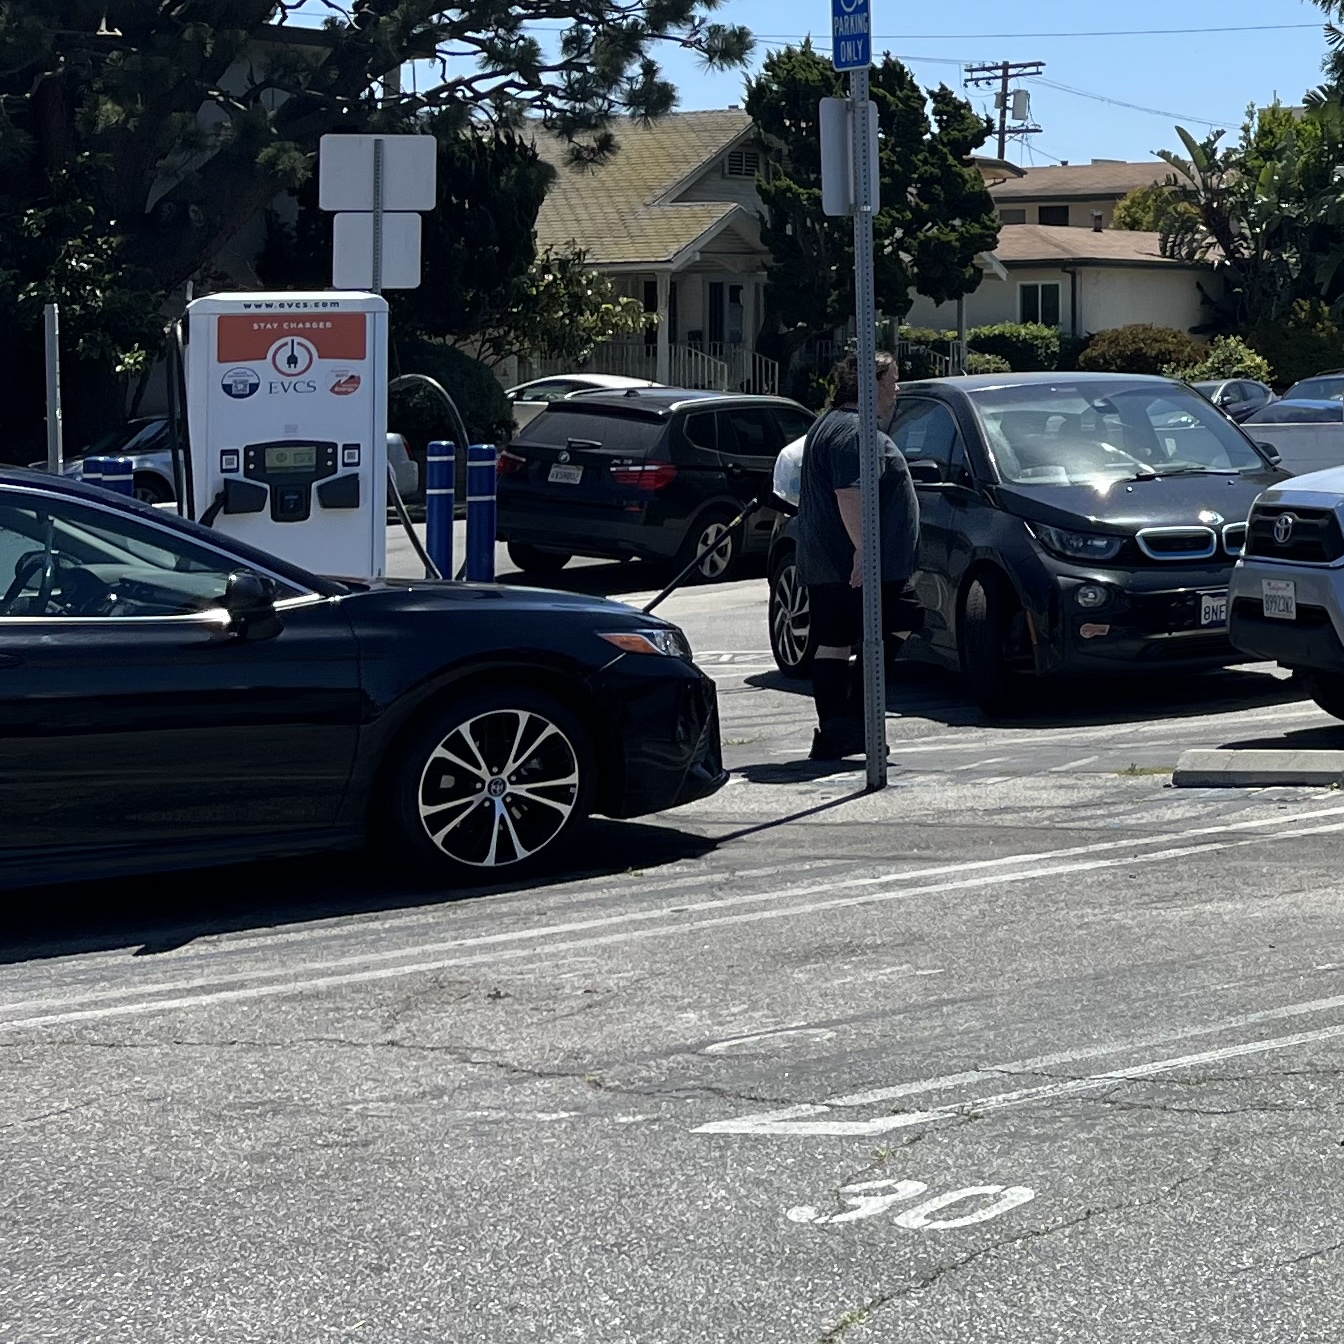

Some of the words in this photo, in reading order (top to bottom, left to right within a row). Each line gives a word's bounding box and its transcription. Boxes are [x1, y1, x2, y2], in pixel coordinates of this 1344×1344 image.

[834, 12, 868, 37] PARKING
[840, 39, 863, 62] ONLY
[243, 301, 340, 310] www.evcs.com
[253, 322, 278, 330] STAY
[282, 321, 332, 330] CHARGED
[268, 380, 317, 395] EVCS
[786, 1180, 1035, 1229] 30
